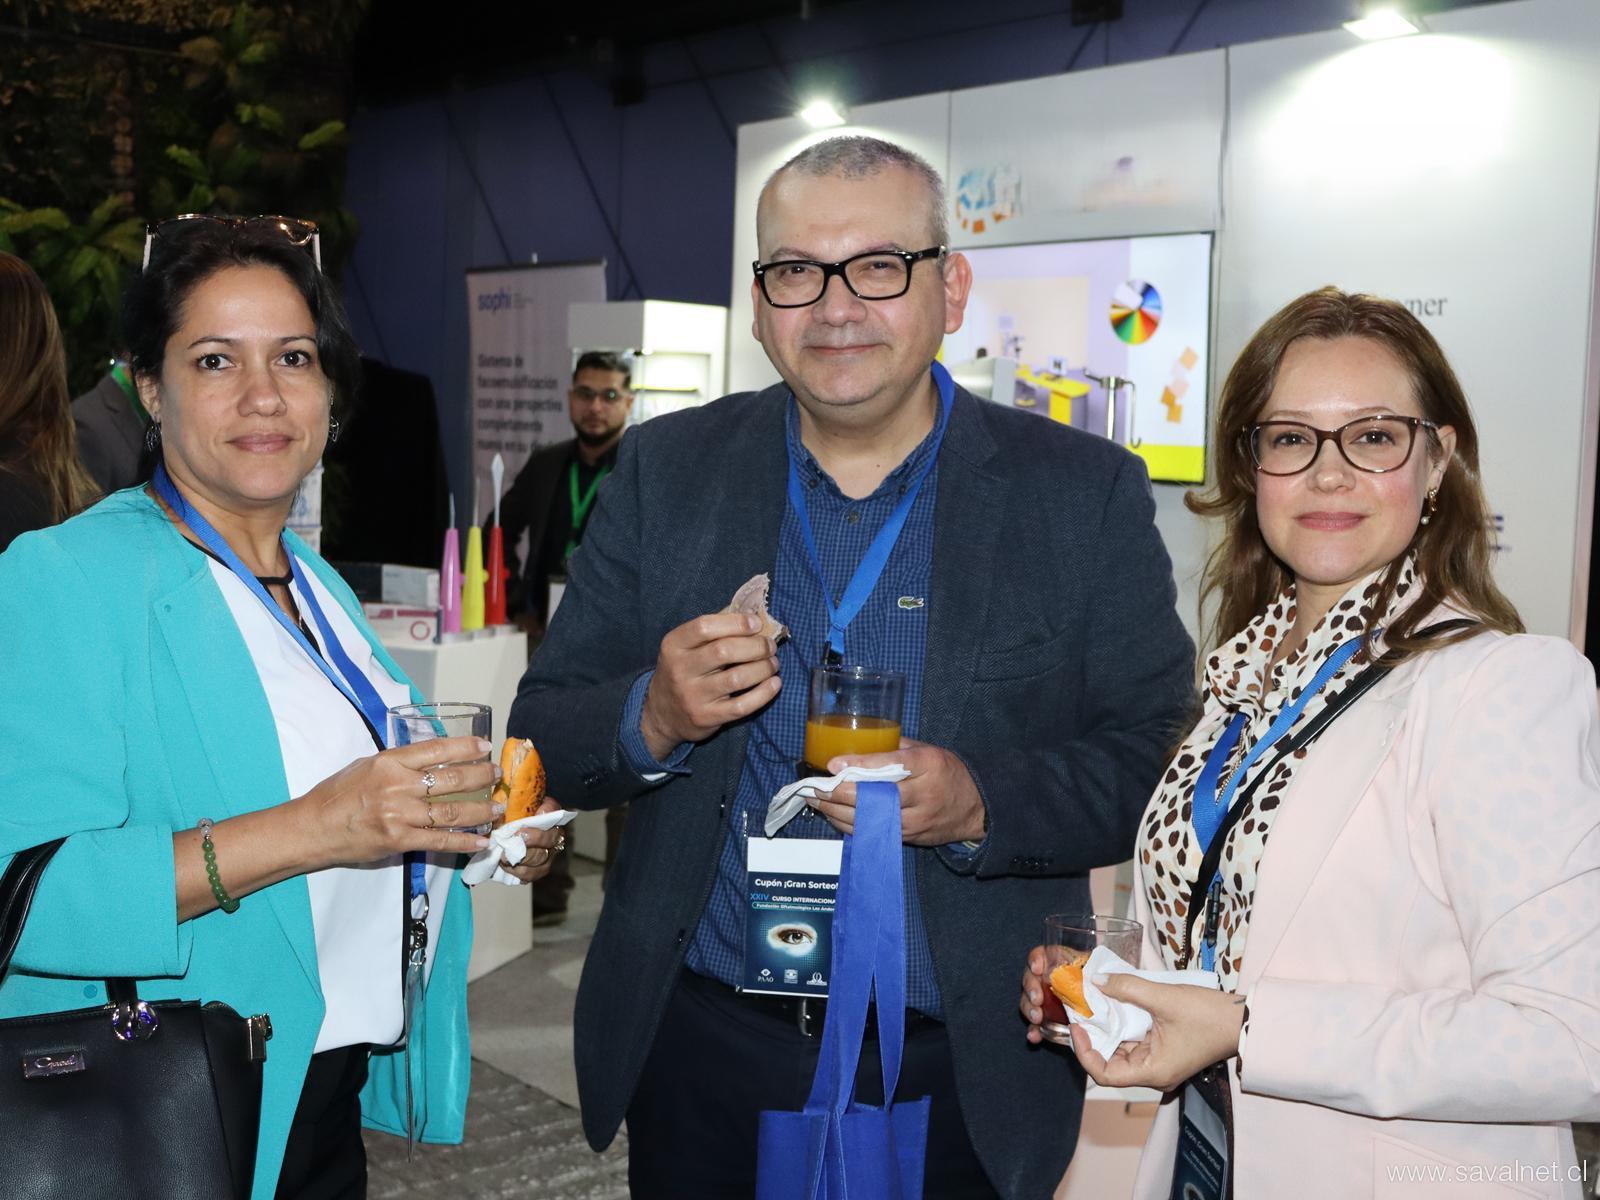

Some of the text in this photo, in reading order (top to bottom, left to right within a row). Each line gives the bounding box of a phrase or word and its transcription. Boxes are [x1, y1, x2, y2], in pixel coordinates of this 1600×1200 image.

[755, 878, 839, 890] Cupón ¡Gran Sorteo!
